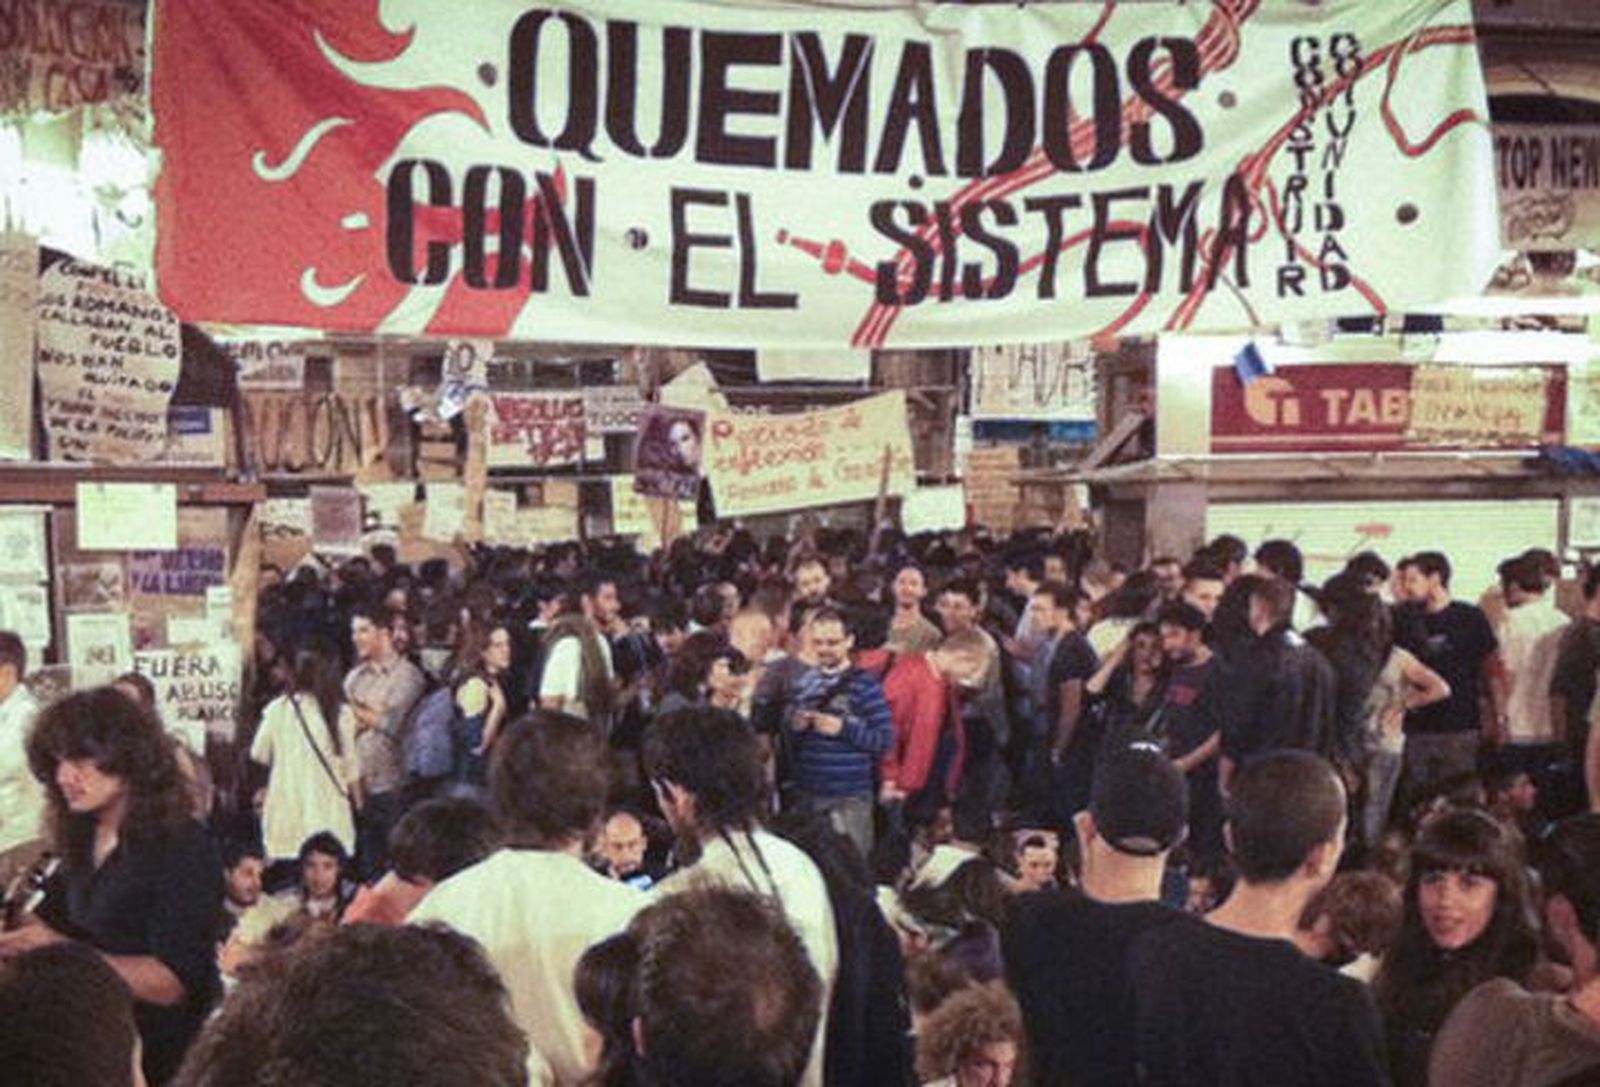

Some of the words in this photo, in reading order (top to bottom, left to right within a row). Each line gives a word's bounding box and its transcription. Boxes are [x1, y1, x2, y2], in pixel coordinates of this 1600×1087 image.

[508, 9, 1204, 178] QUEMADOS
[386, 158, 597, 298] CON
[669, 186, 800, 309] EL
[869, 172, 1250, 307] SISTEMA
[90, 332, 178, 361] PUEBLO
[133, 655, 221, 678] FUERA
